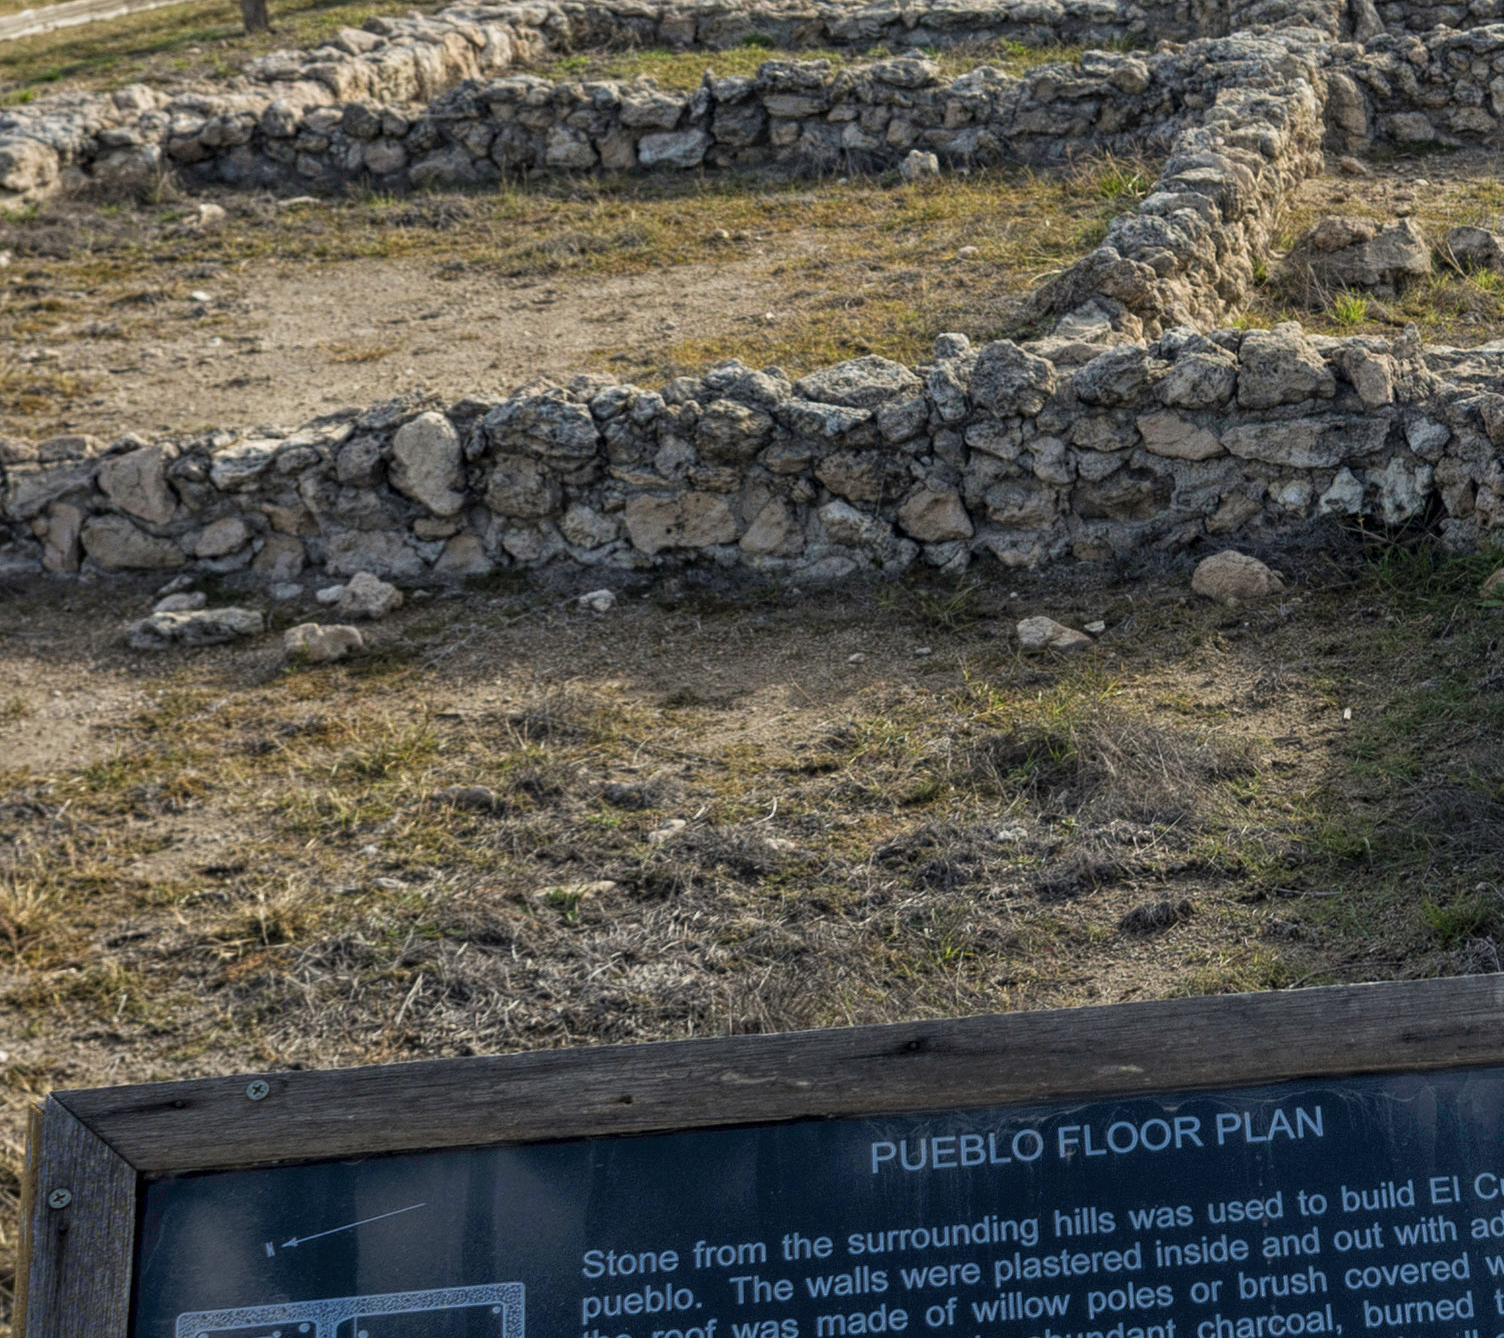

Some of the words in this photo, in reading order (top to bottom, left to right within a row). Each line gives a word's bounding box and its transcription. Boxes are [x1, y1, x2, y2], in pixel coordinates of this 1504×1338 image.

[871, 1128, 1044, 1175] PUEBLO
[1057, 1115, 1205, 1162] FLOOR
[1215, 1105, 1324, 1146] PLAN
[581, 1282, 703, 1326] pueblo.
[728, 1274, 794, 1305] The
[805, 1265, 889, 1299] walls
[900, 1262, 981, 1290] were
[994, 1241, 1143, 1289] plastered
[1155, 1234, 1249, 1268] inside
[1262, 1225, 1321, 1259] and
[1333, 1221, 1385, 1252] out
[1393, 1215, 1458, 1246] with
[582, 1249, 680, 1279] Stone
[692, 1239, 767, 1269] from
[781, 1231, 834, 1262] the
[847, 1214, 1039, 1255] surrounding
[1053, 1206, 1117, 1238] hills
[1127, 1205, 1194, 1231] was
[1207, 1190, 1284, 1224] used
[1296, 1189, 1328, 1216] to
[1340, 1178, 1416, 1213] build
[1429, 1175, 1461, 1205] El
[816, 1302, 909, 1338] made
[925, 1296, 958, 1328] of
[971, 1291, 1071, 1324] willow
[1087, 1281, 1174, 1320] poles
[1189, 1280, 1224, 1304] or
[1238, 1265, 1328, 1300] brush
[1344, 1251, 1471, 1290] covered
[1363, 1290, 1475, 1329] burned
